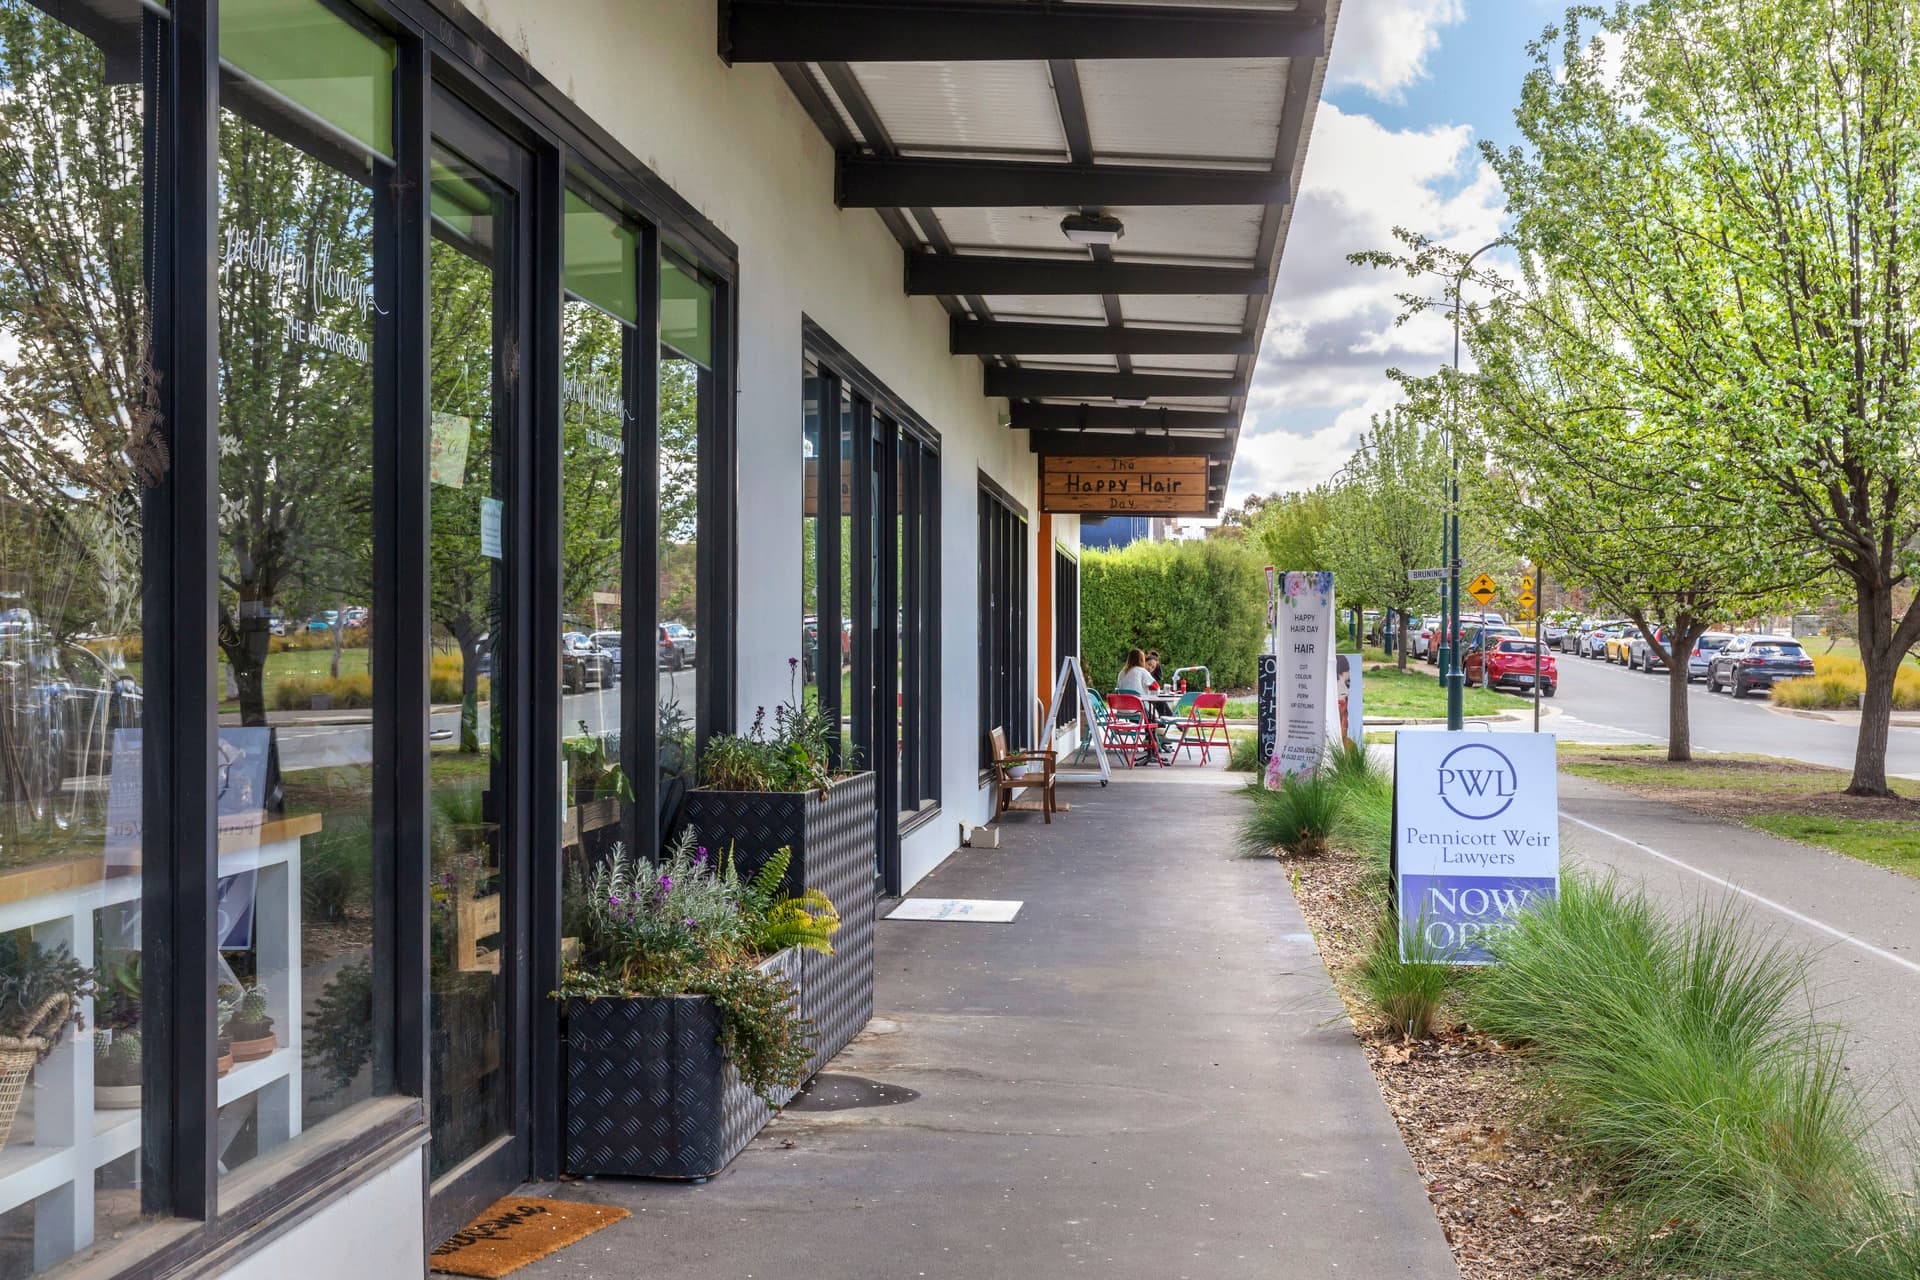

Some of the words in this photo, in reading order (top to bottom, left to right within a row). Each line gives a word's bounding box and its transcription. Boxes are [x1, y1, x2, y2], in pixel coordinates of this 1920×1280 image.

[284, 315, 306, 342] THE
[308, 323, 368, 363] WORKROOM
[1111, 459, 1135, 470] The
[1067, 475, 1128, 492] Happy
[1140, 475, 1182, 492] Hair
[1110, 497, 1135, 509] Day
[1413, 569, 1443, 579] BRUNING
[1290, 625, 1305, 633] HAIR
[1306, 625, 1319, 633] DAY
[1294, 643, 1315, 654] HAIR
[1437, 768, 1516, 798] PWL
[1407, 828, 1497, 846] Pennicott
[1502, 829, 1551, 847] Weir
[1443, 847, 1516, 868] Lawyers
[1427, 887, 1532, 916] NOW
